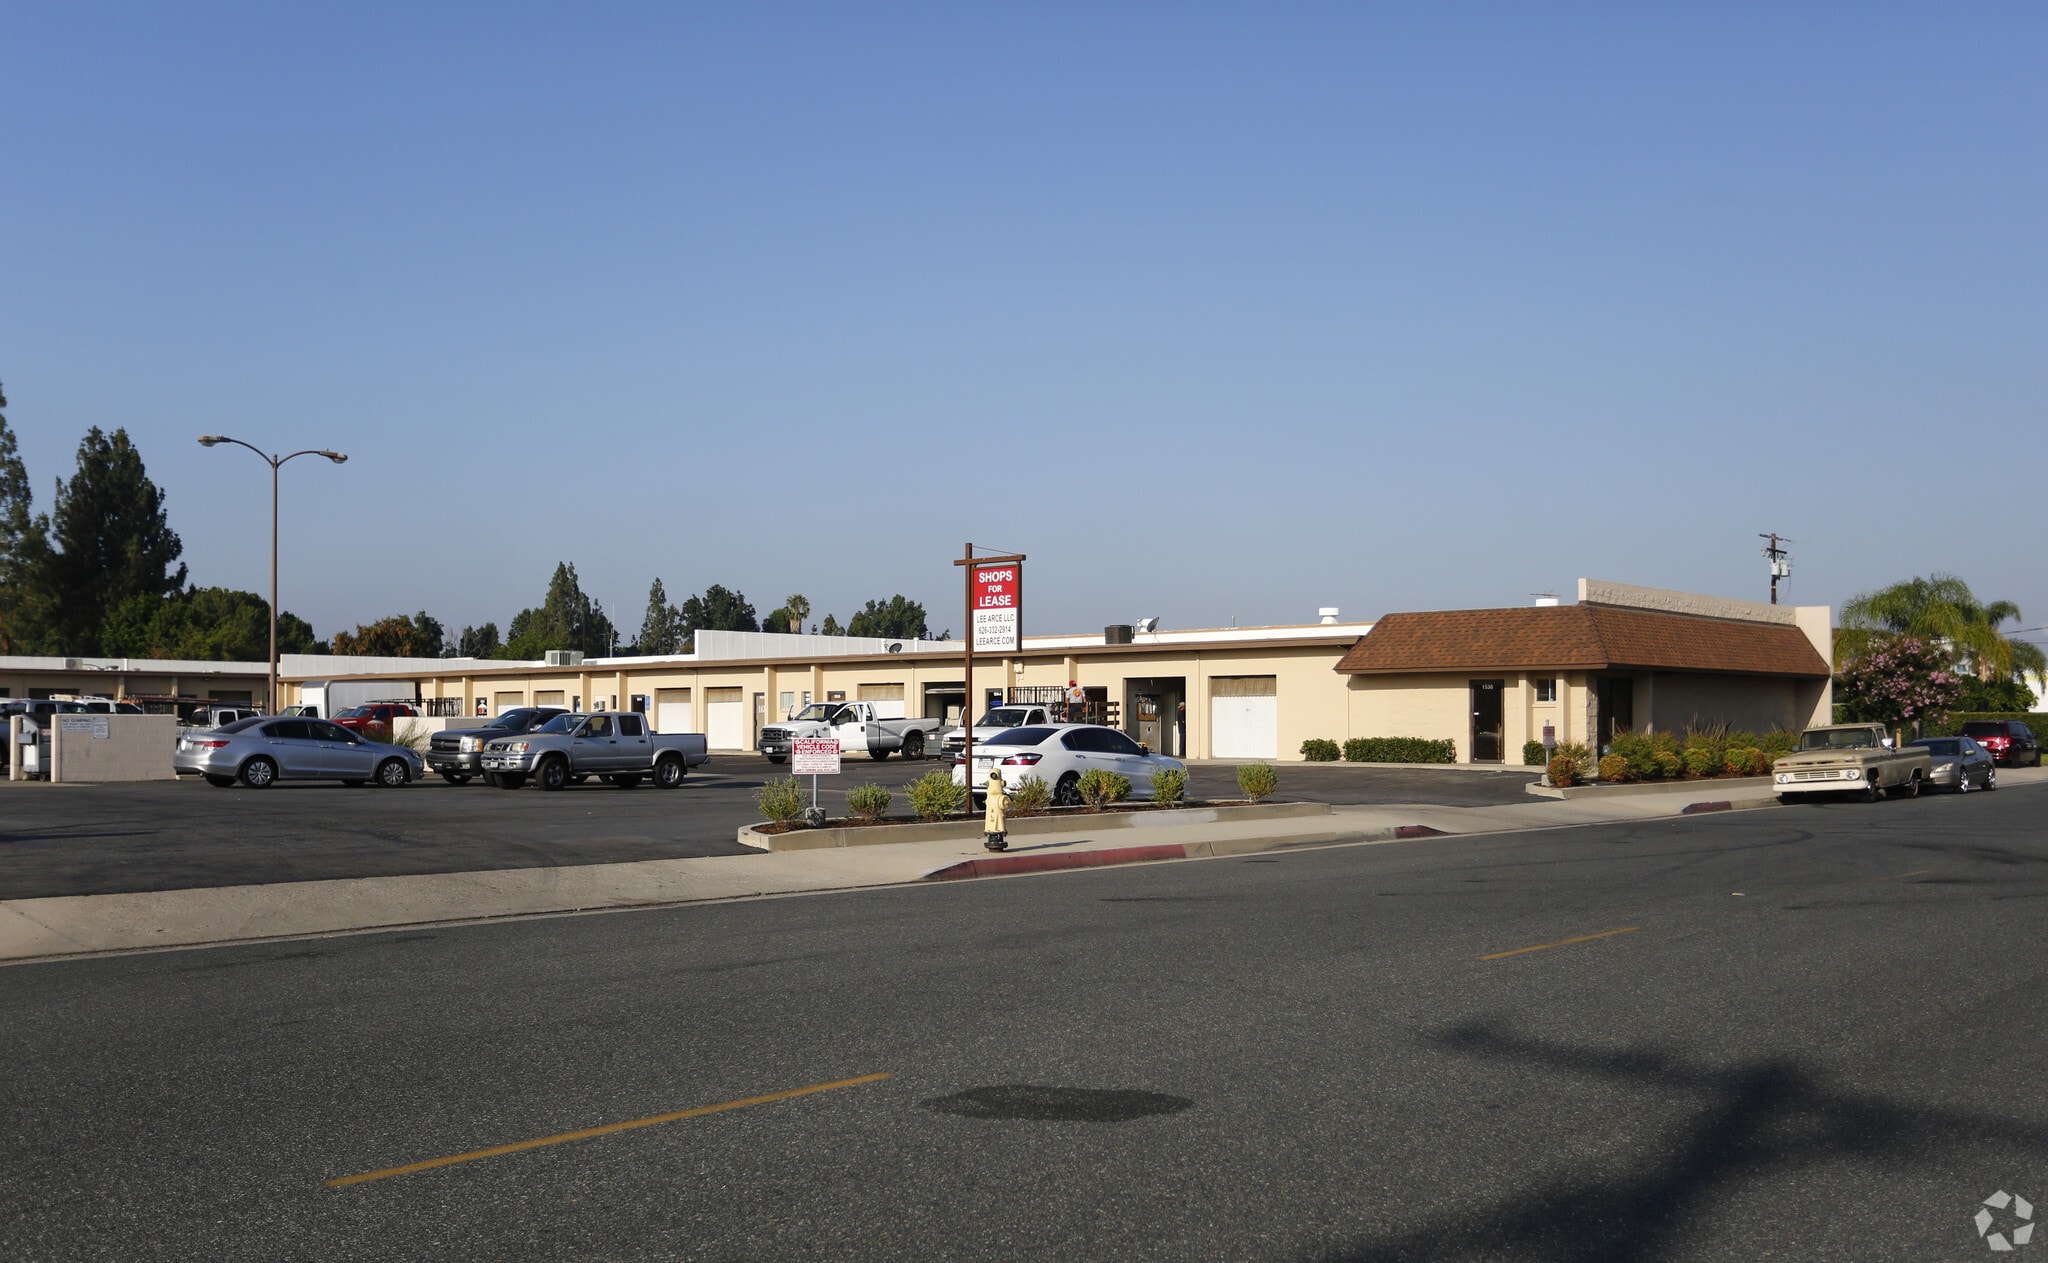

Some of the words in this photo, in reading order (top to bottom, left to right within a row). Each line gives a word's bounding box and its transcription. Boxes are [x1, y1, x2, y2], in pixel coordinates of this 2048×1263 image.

[978, 570, 1012, 583] SHOPS
[980, 595, 1012, 607] LEASE
[977, 615, 986, 623] LEE
[988, 614, 1002, 622] ARCE
[1004, 614, 1014, 622] LLC
[979, 626, 1011, 634] 626-332-2914
[976, 637, 1014, 645] LEEARCE.COM
